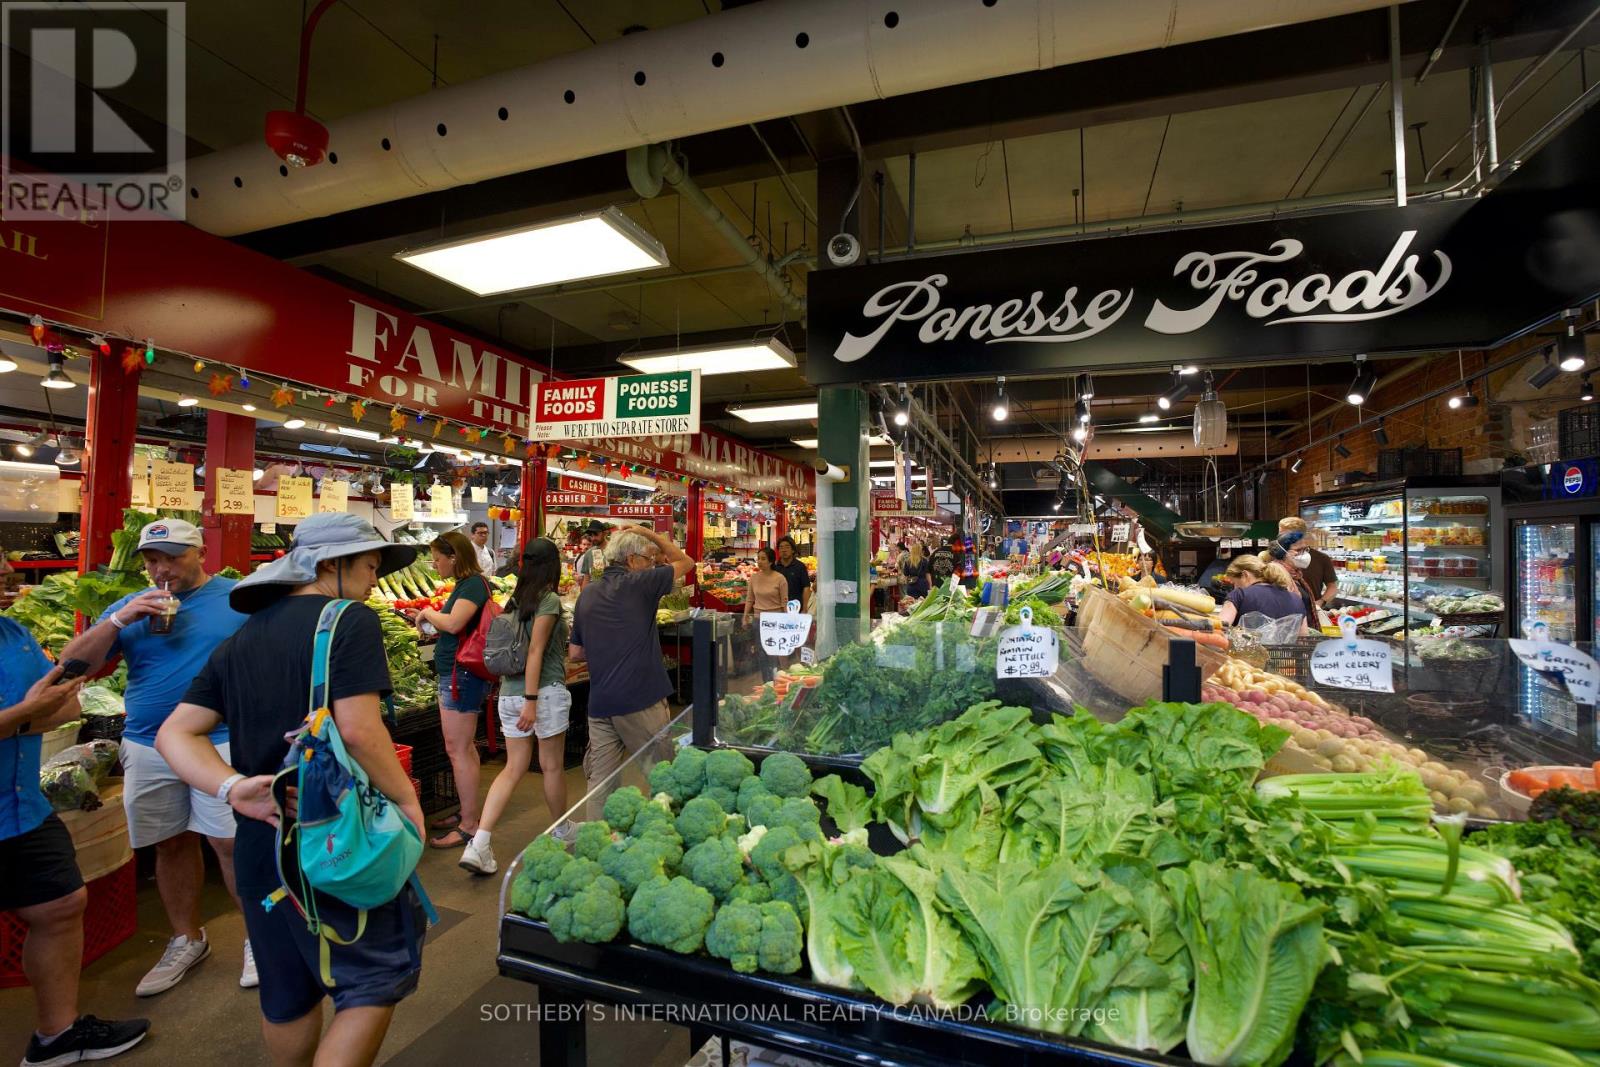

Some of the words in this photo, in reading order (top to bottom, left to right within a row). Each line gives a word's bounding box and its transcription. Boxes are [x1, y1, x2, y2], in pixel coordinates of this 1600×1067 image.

[832, 272, 1134, 363] Ponesse
[1144, 229, 1453, 335] Foods
[346, 363, 439, 406] FOR
[619, 378, 689, 397] PONESSE
[543, 385, 598, 402] FAMILY
[543, 400, 597, 416] FOODS
[628, 395, 678, 411] FOODS
[563, 422, 589, 438] WE'RE
[591, 420, 609, 437] TWO
[611, 419, 653, 436] SEPARATE
[655, 416, 689, 433] STORES
[700, 431, 784, 480] MARKET
[568, 479, 598, 493] CASHIER
[545, 493, 586, 503] CASHIER
[617, 506, 654, 514] CASHIER
[659, 506, 665, 514] 2
